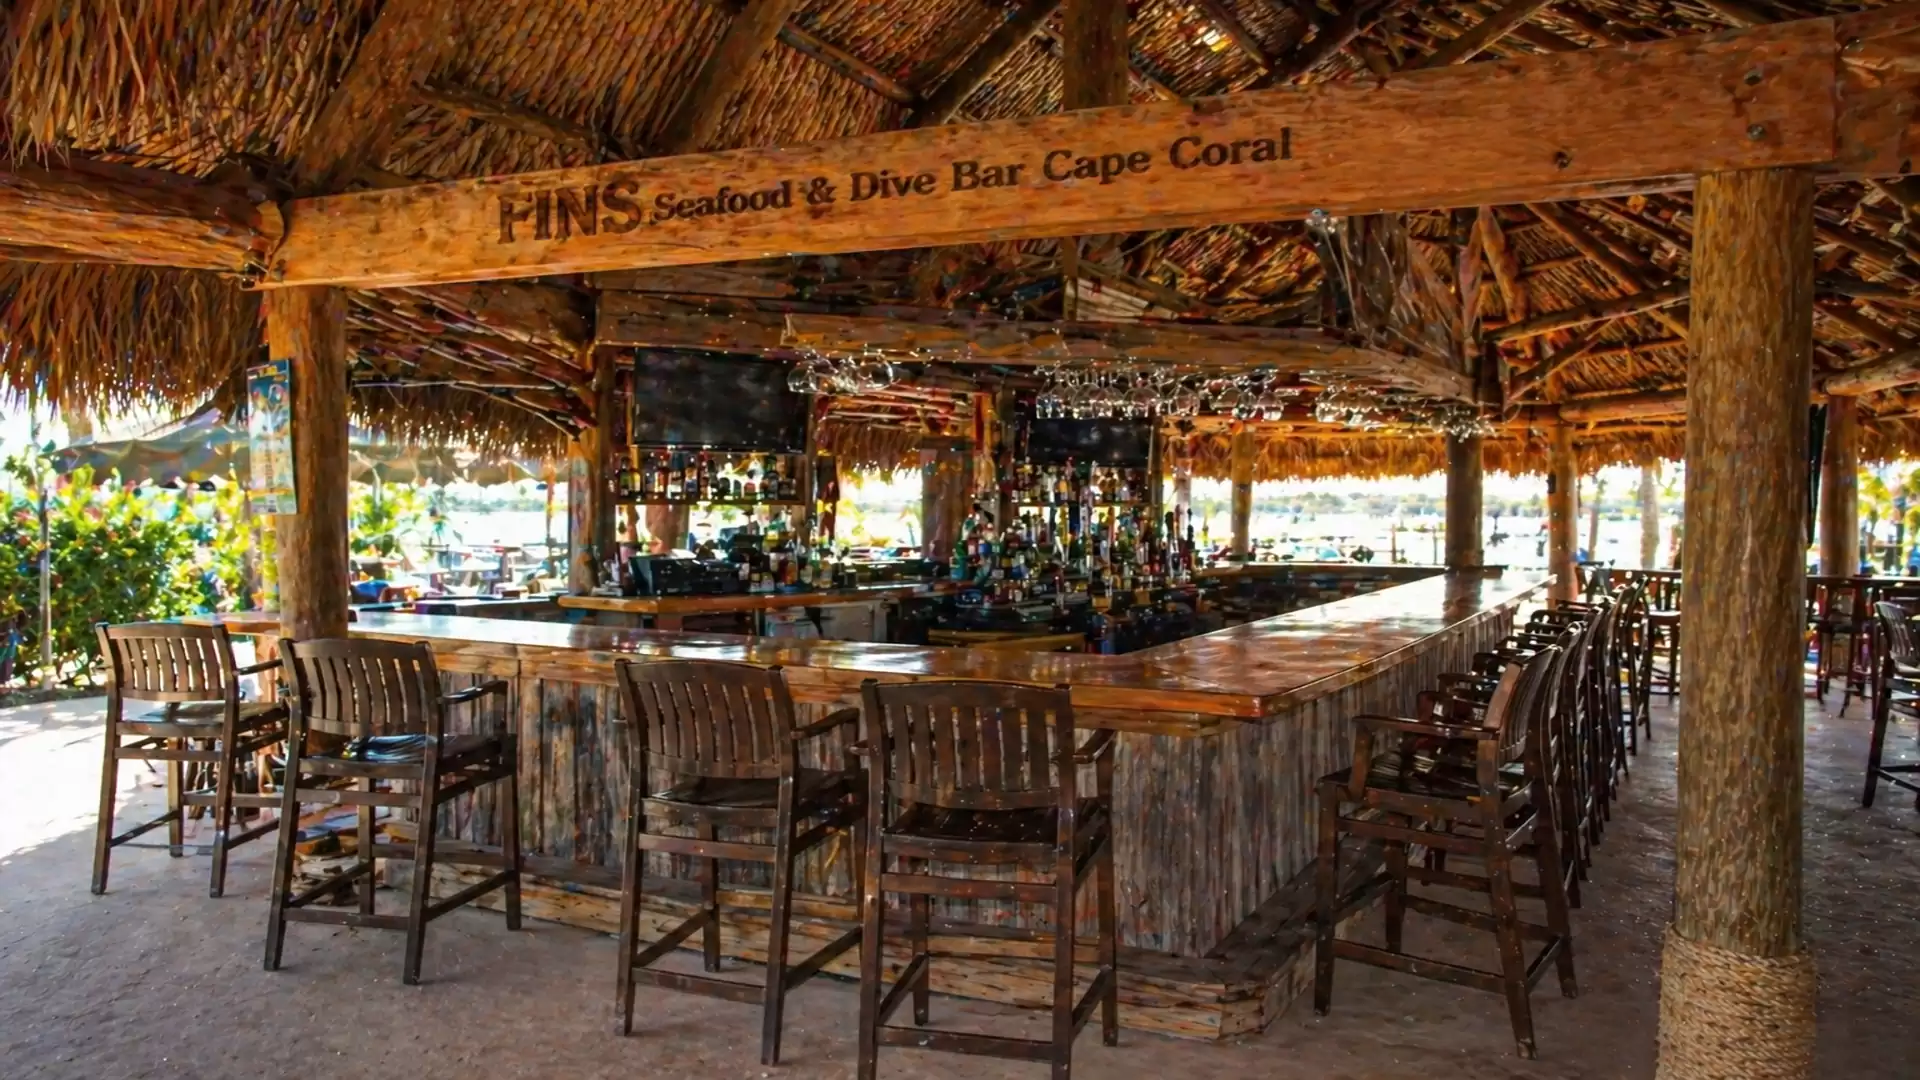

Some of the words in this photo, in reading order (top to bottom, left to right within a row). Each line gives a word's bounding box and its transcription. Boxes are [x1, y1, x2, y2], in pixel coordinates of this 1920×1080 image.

[497, 173, 643, 244] FINS
[652, 179, 792, 222] Seafood
[806, 176, 837, 206] &
[850, 168, 937, 201] Dive
[951, 160, 1026, 191] Bar
[1043, 149, 1152, 184] Cape
[1169, 126, 1292, 170] Coral
